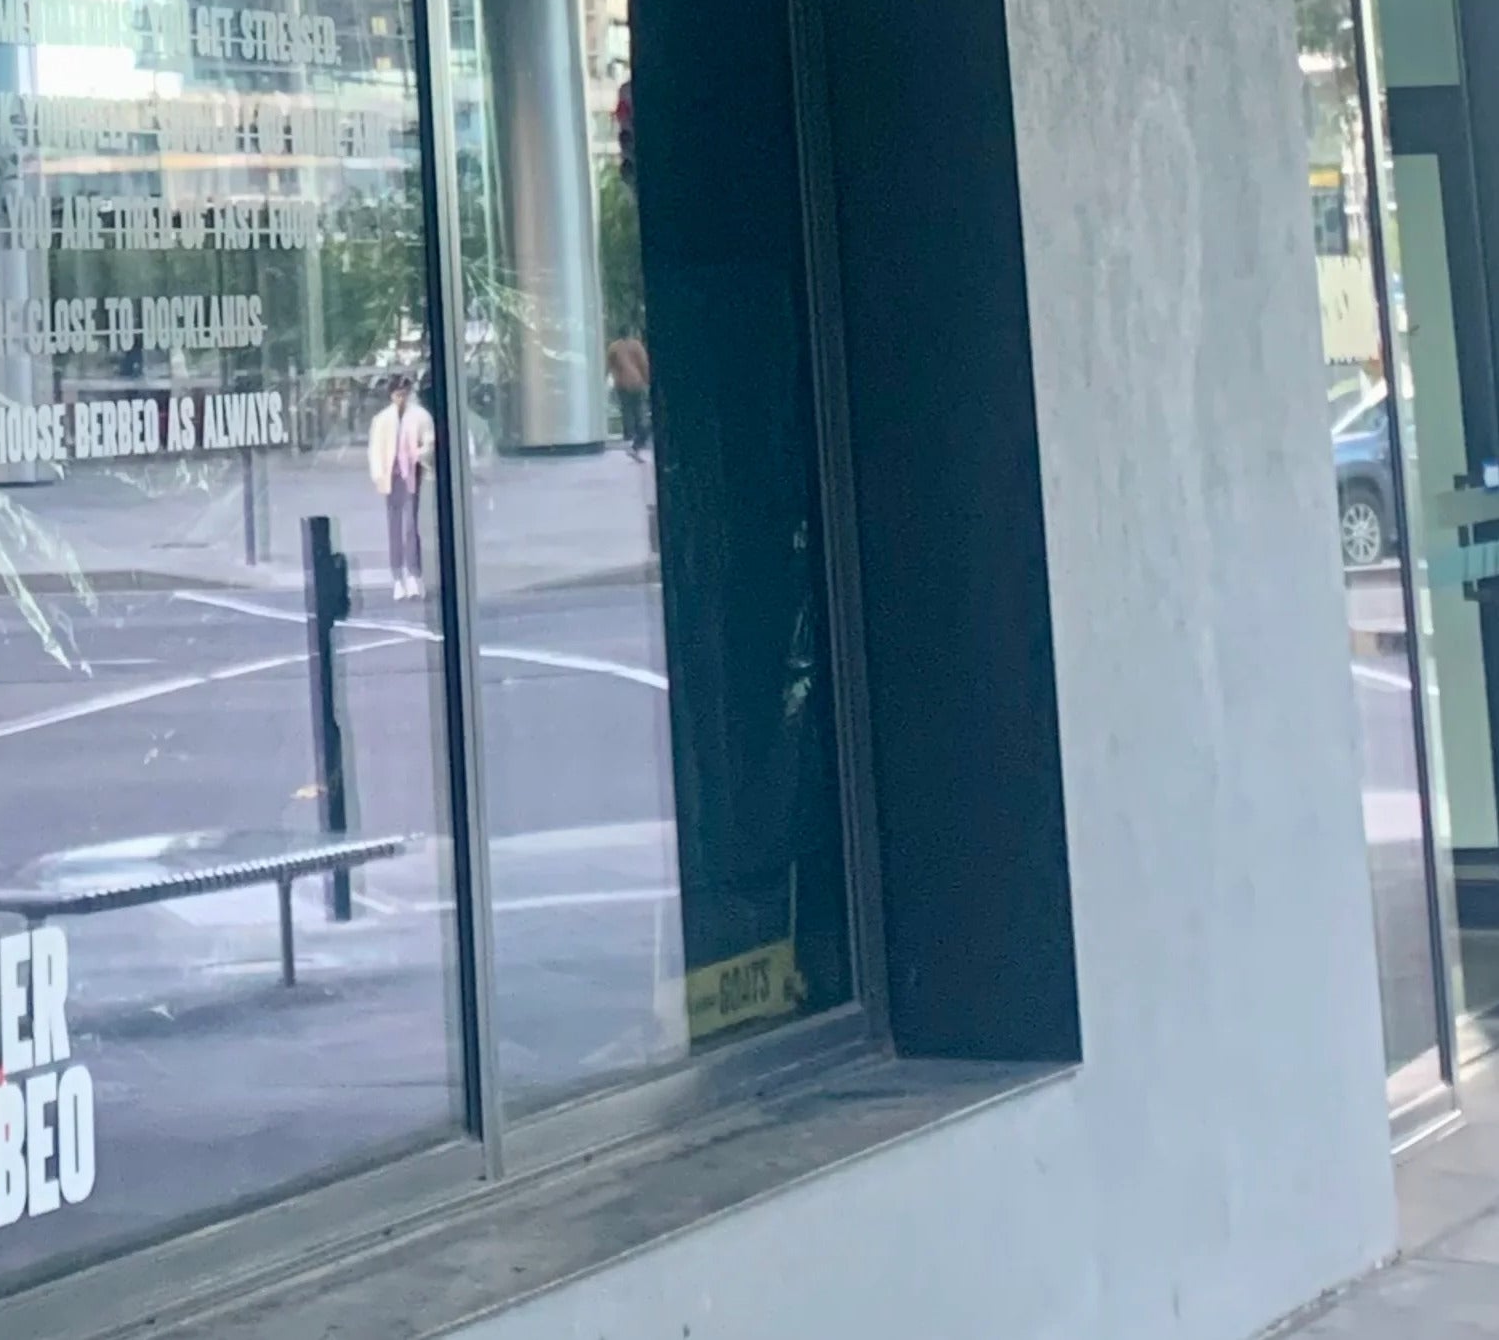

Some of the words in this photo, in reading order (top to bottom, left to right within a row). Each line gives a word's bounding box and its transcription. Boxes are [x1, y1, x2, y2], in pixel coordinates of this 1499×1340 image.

[197, 5, 233, 57] GET
[241, 8, 341, 65] STRESSED.
[6, 195, 52, 250] YOU
[61, 196, 104, 249] ARE
[28, 298, 99, 354] CLOSE
[104, 297, 134, 352] TO
[75, 398, 160, 458] BERBEO
[167, 397, 195, 452] AS
[203, 392, 288, 449] ALWAYS.
